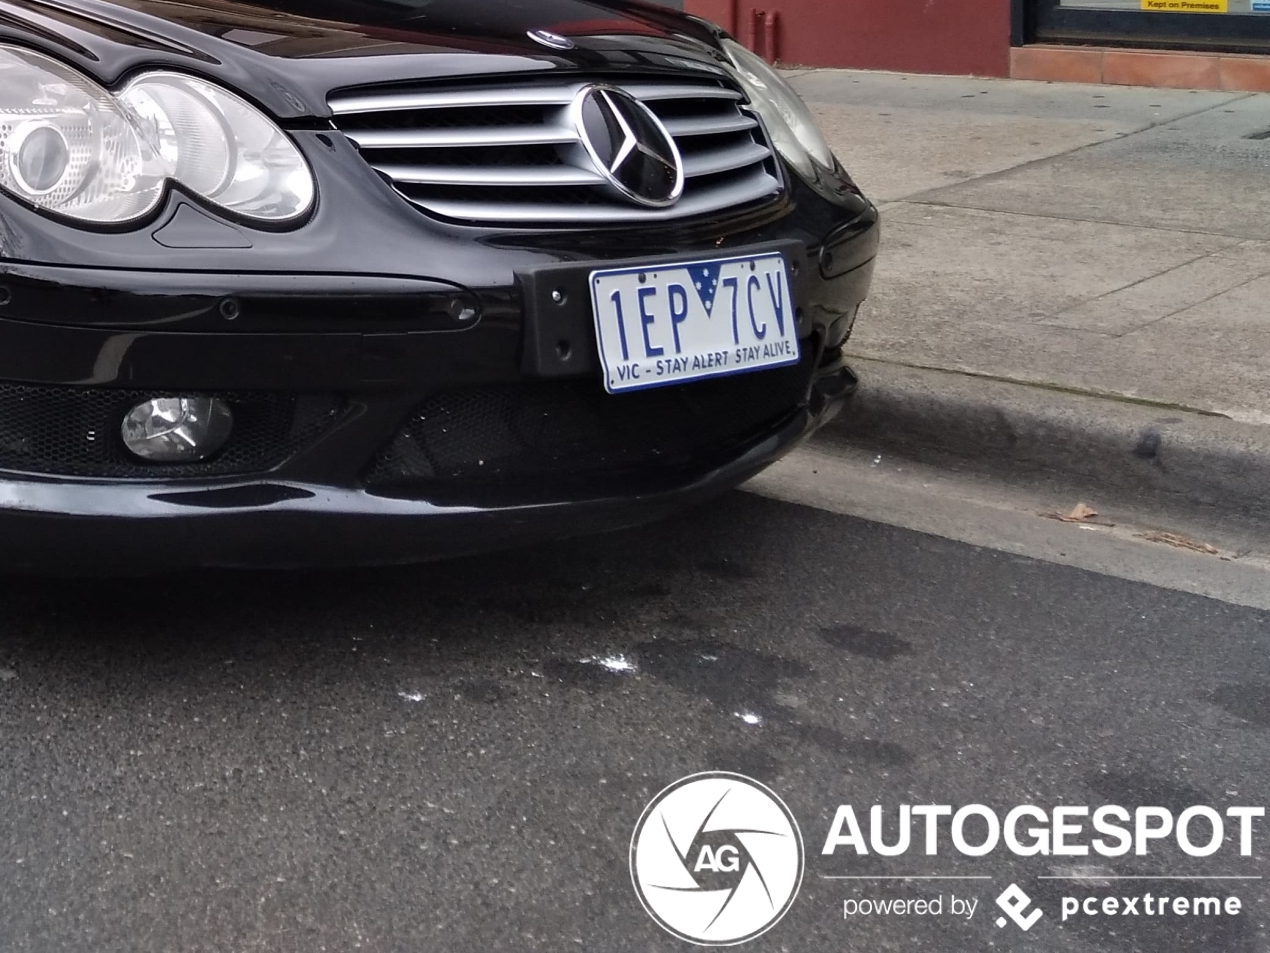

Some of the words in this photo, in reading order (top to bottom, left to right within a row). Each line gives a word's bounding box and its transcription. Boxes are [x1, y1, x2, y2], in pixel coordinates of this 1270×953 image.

[1148, 1, 1167, 9] Kept
[1181, 1, 1219, 10] Premises
[611, 283, 688, 361] 1EP
[722, 271, 785, 345] 7CV
[617, 363, 640, 381] VIC
[656, 359, 688, 376] STAY
[692, 351, 729, 370] ALERT
[735, 346, 760, 364] STAY
